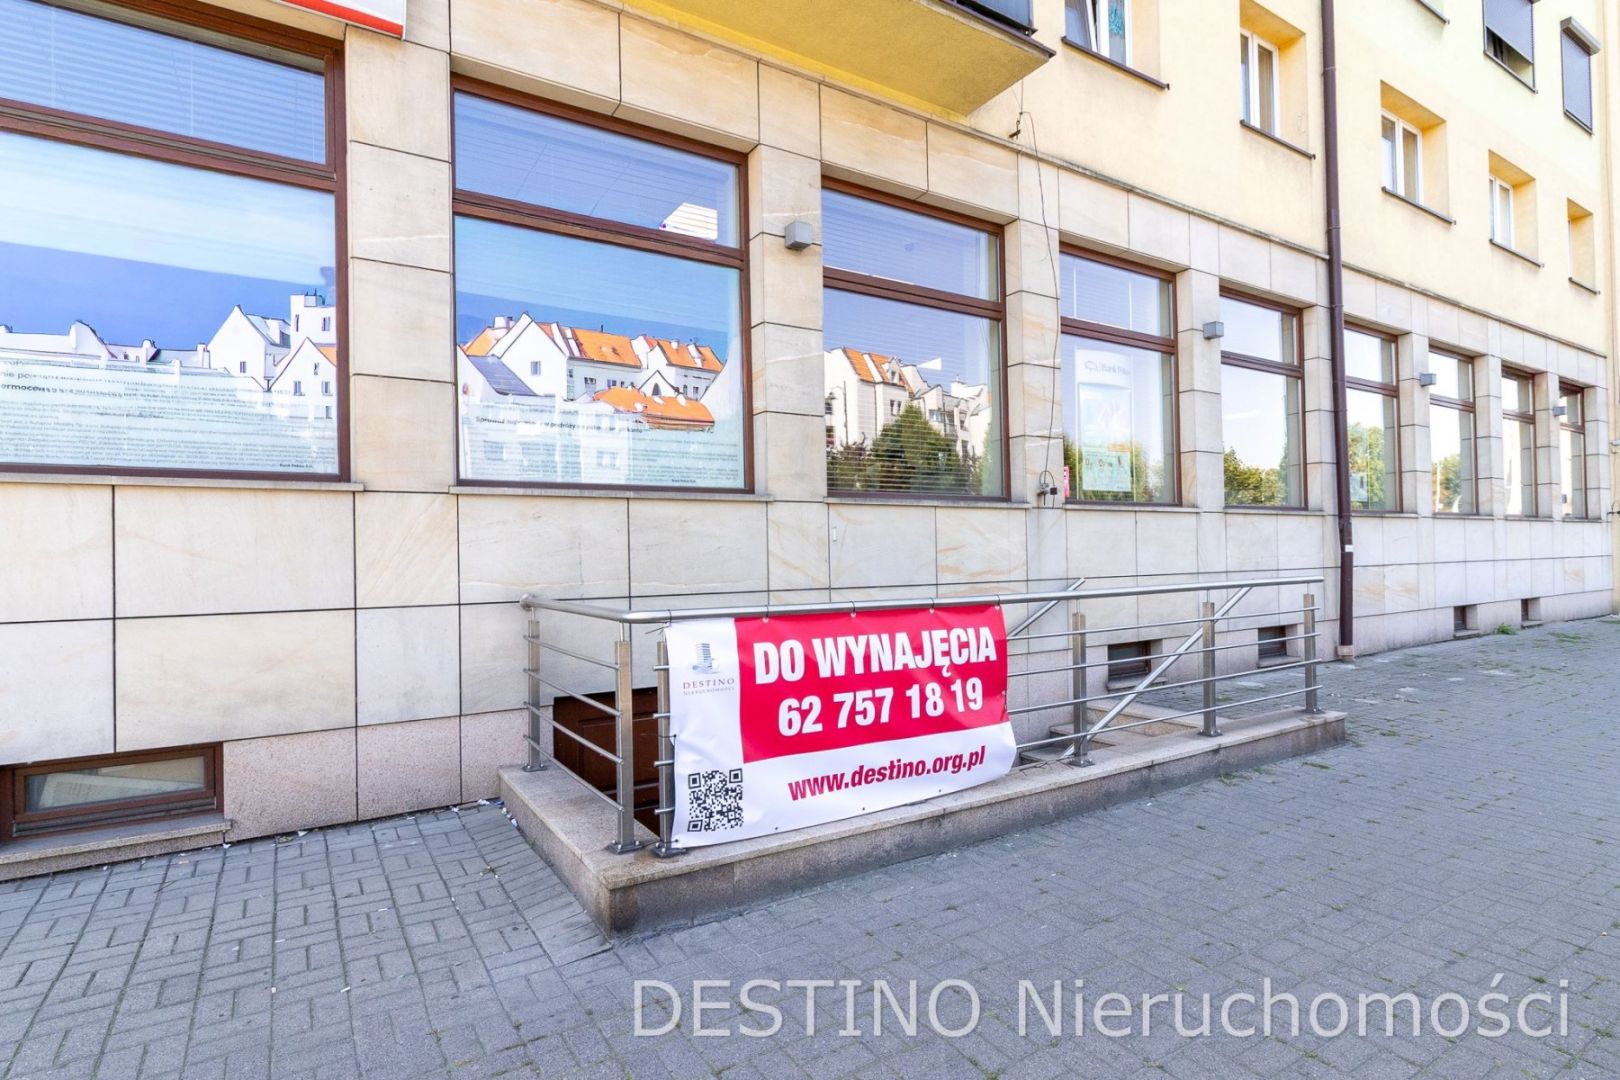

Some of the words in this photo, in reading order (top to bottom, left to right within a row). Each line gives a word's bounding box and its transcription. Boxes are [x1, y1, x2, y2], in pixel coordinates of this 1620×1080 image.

[682, 677, 735, 690] DESTINO
[753, 639, 806, 685] DO
[812, 626, 997, 678] WYNAJĘCIA
[778, 695, 823, 737] 62
[833, 687, 894, 729] 757
[905, 682, 945, 719] 18
[950, 677, 983, 713] 19
[788, 745, 986, 801] www.destino.org.pl
